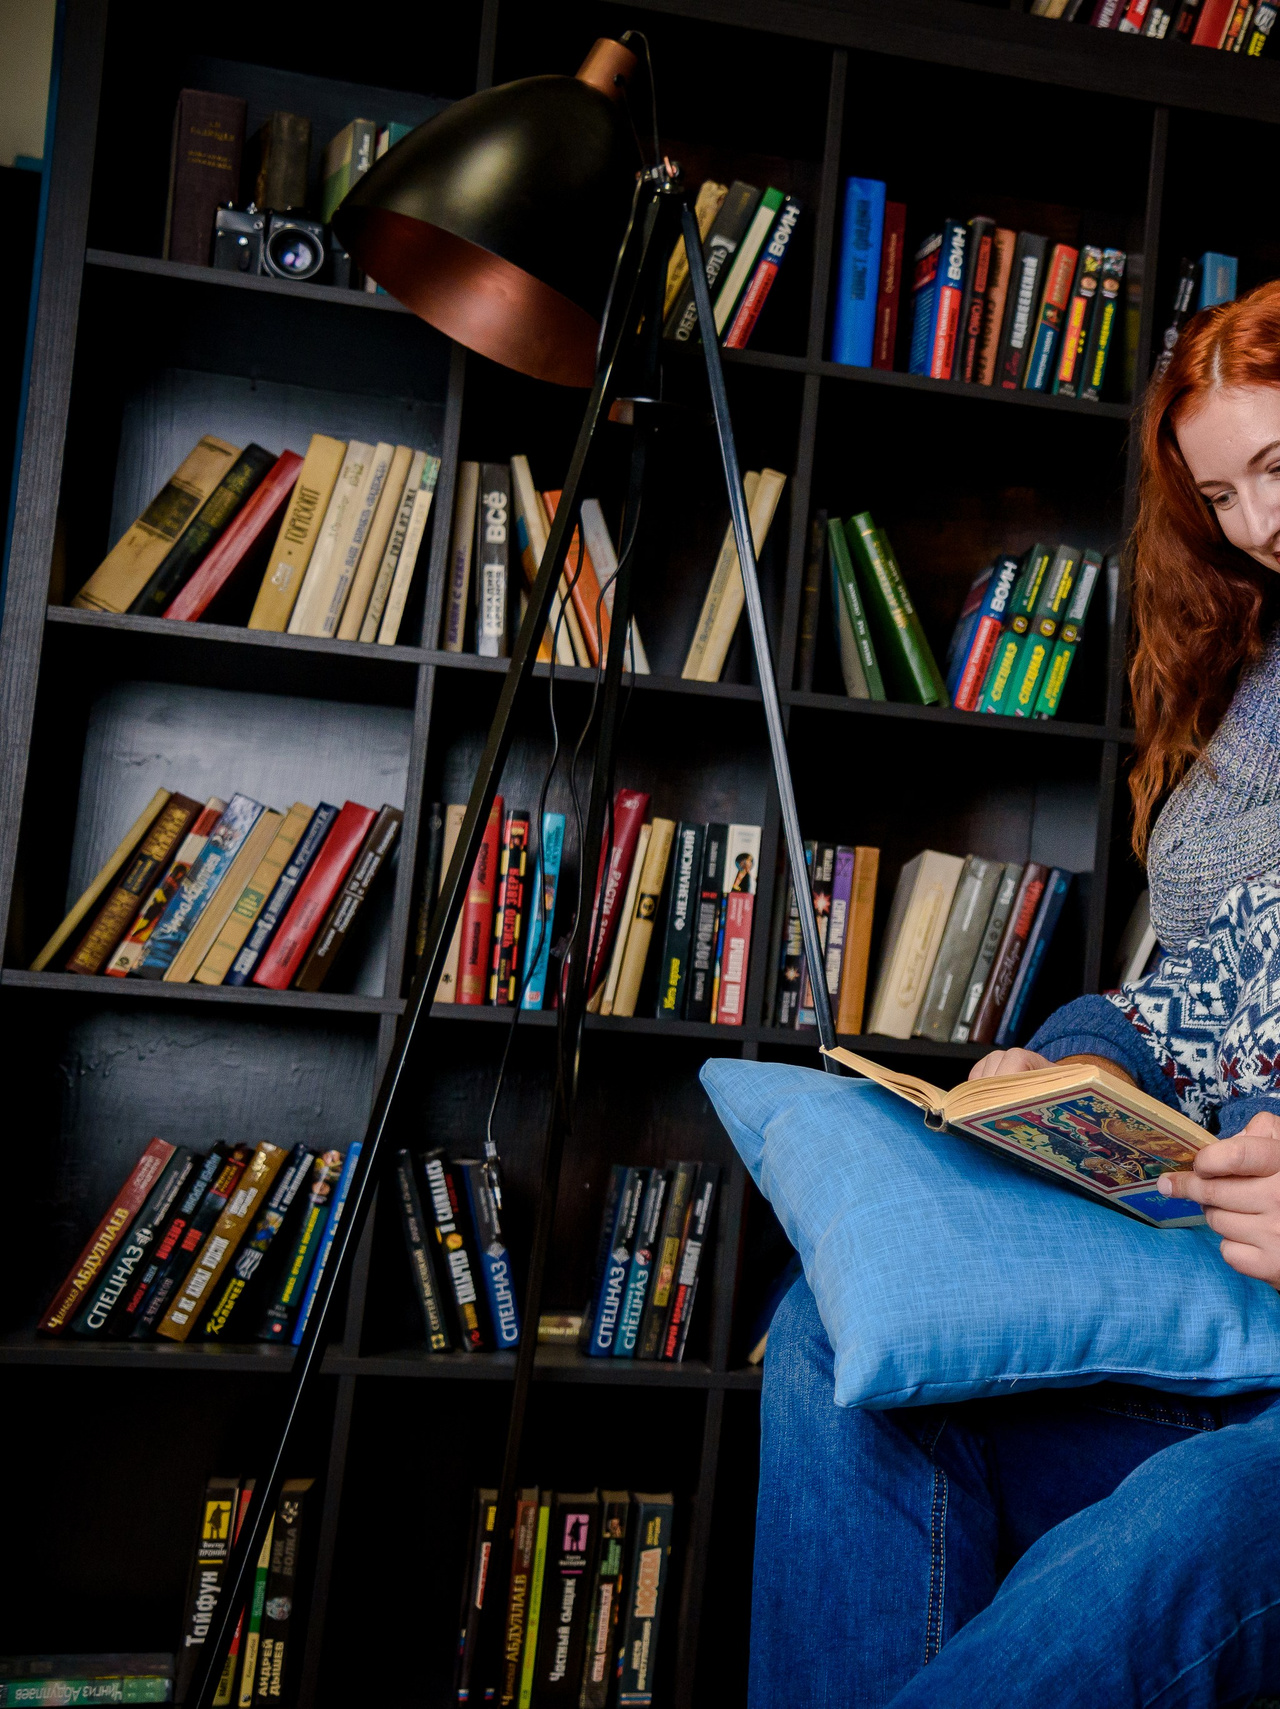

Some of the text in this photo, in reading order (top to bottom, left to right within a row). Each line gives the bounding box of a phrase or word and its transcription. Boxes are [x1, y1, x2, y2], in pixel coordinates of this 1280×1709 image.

[768, 203, 801, 258] ВОИН
[947, 226, 966, 280] ВОИН
[988, 560, 1019, 613] ВОИН
[501, 867, 520, 948] ЧИСЛО ЗВЕРЯ
[71, 1204, 131, 1292] АБДУЛЛАЕВ
[84, 1241, 145, 1331] СПЕЦНАЗ
[488, 1259, 519, 1342] СПЕЦНАЗ
[595, 1264, 626, 1349] СПЕЦНАЗ
[622, 1268, 649, 1350] СПЕЦНАЗ
[186, 1571, 222, 1648] Тайфун
[505, 1573, 529, 1663] АБДУЛЛАЕВ
[13, 1678, 122, 1705] Чингиз Абдуллаев
[256, 1636, 273, 1696] АНДРЕЙ
[268, 1639, 285, 1696] ДЫШЕВ
